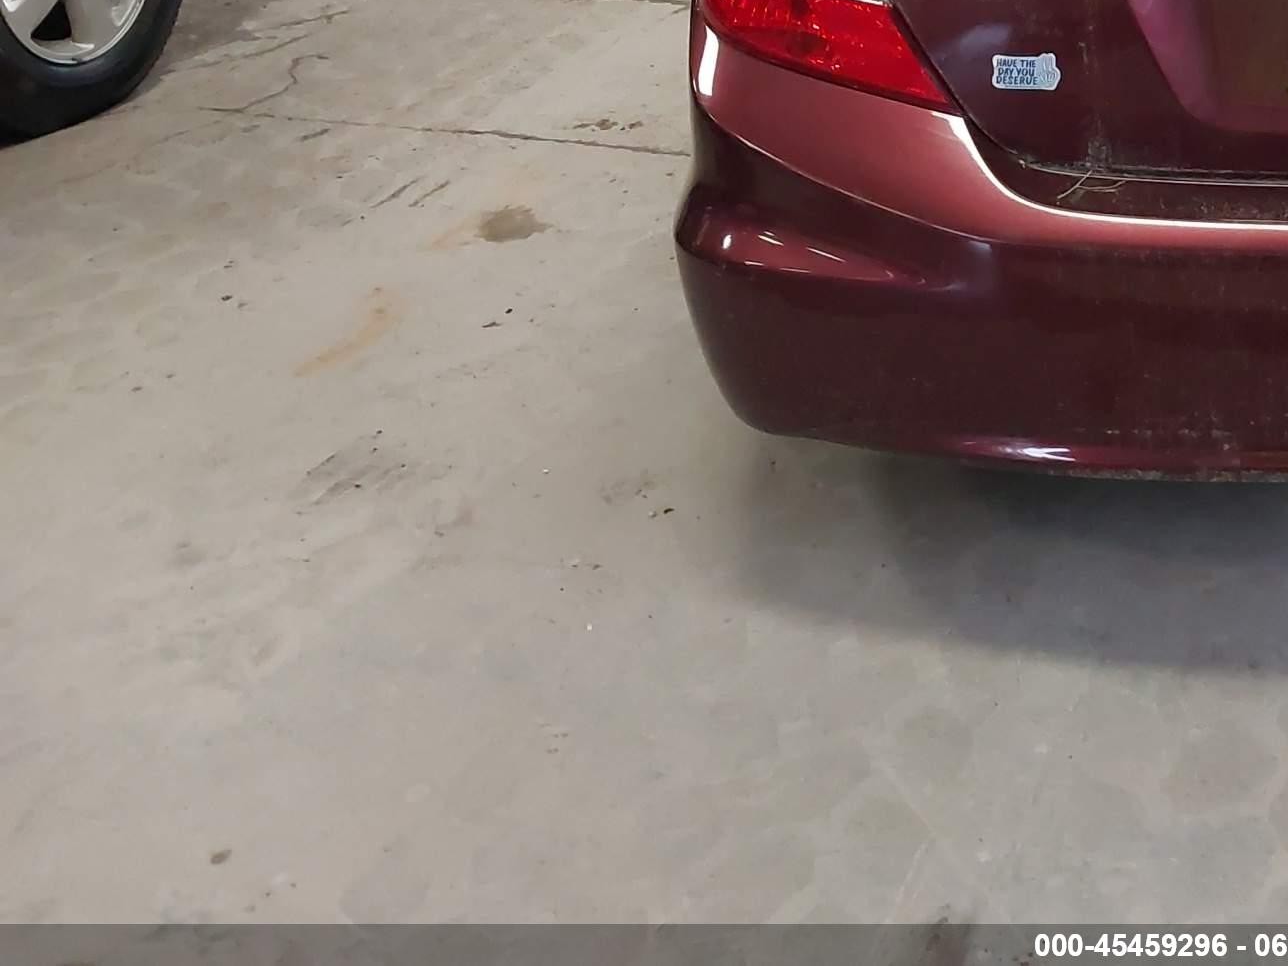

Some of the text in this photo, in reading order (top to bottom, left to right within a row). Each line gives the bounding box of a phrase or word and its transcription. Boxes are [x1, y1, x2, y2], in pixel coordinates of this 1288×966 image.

[996, 58, 1036, 68] HAVE THE
[998, 67, 1035, 76] DAY YOU
[996, 76, 1039, 85] DESERVE
